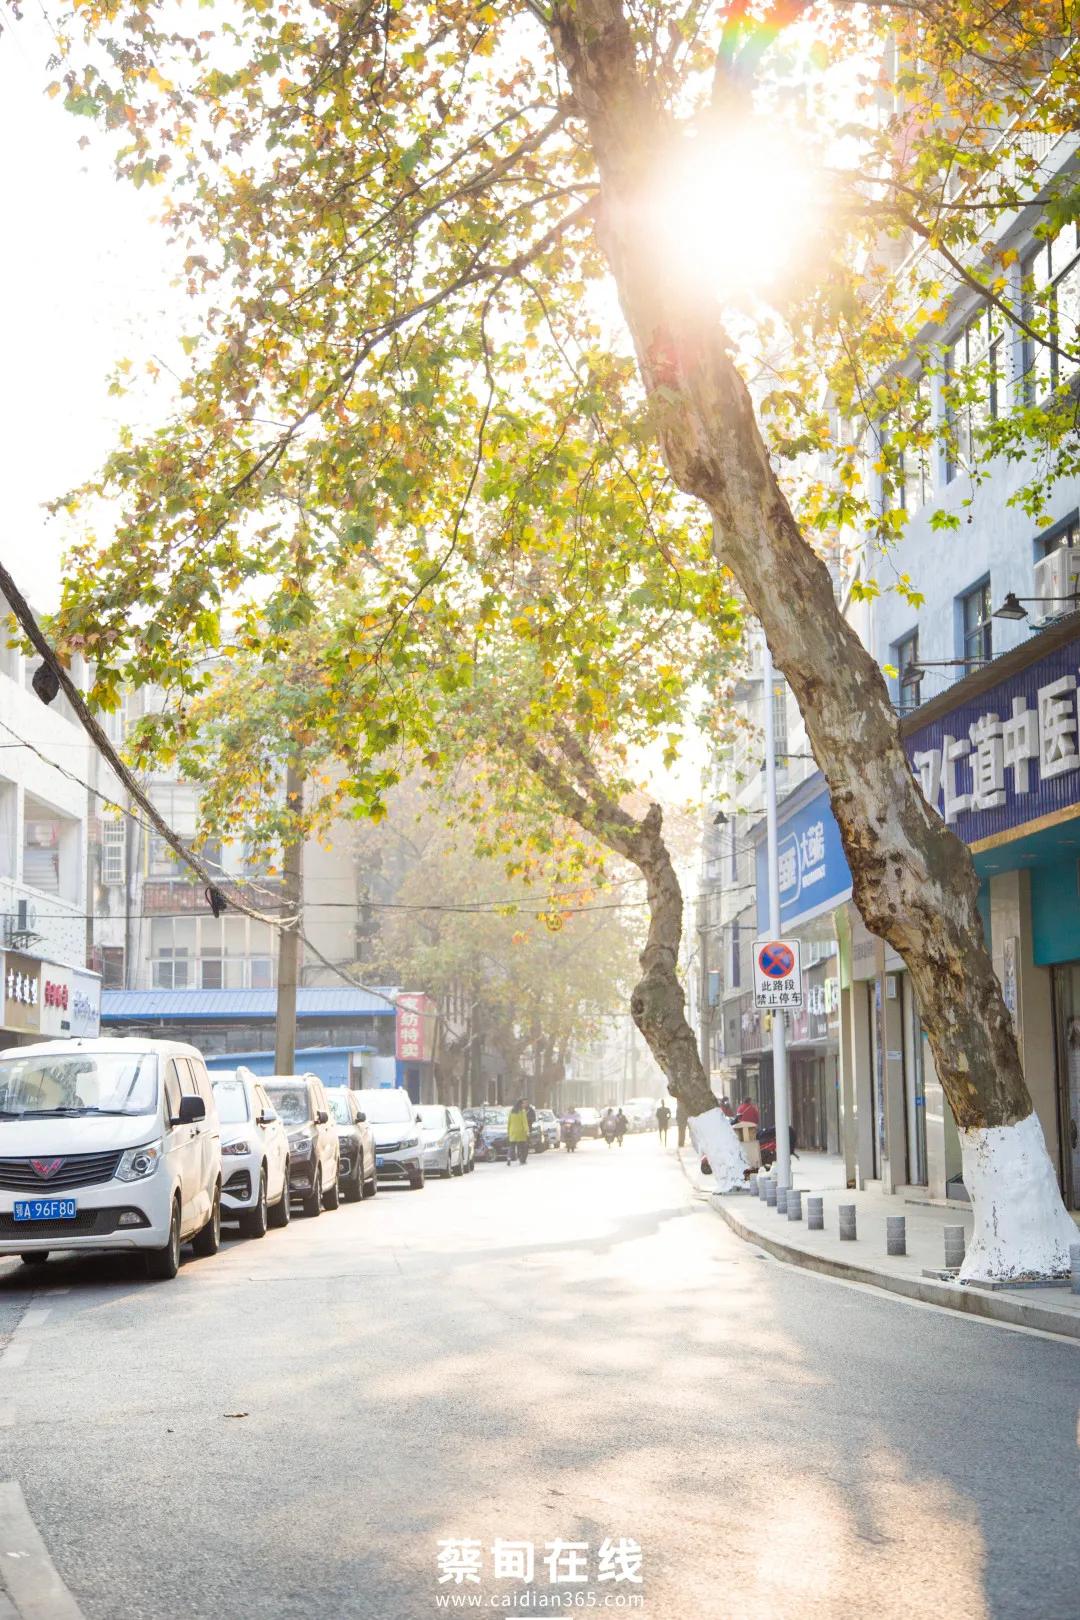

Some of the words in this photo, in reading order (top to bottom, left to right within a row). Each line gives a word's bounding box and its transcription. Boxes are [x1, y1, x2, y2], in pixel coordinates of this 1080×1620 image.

[912, 672, 1080, 825] 仁道中医
[762, 980, 795, 992] 此路段
[757, 992, 802, 1005] 禁止停车
